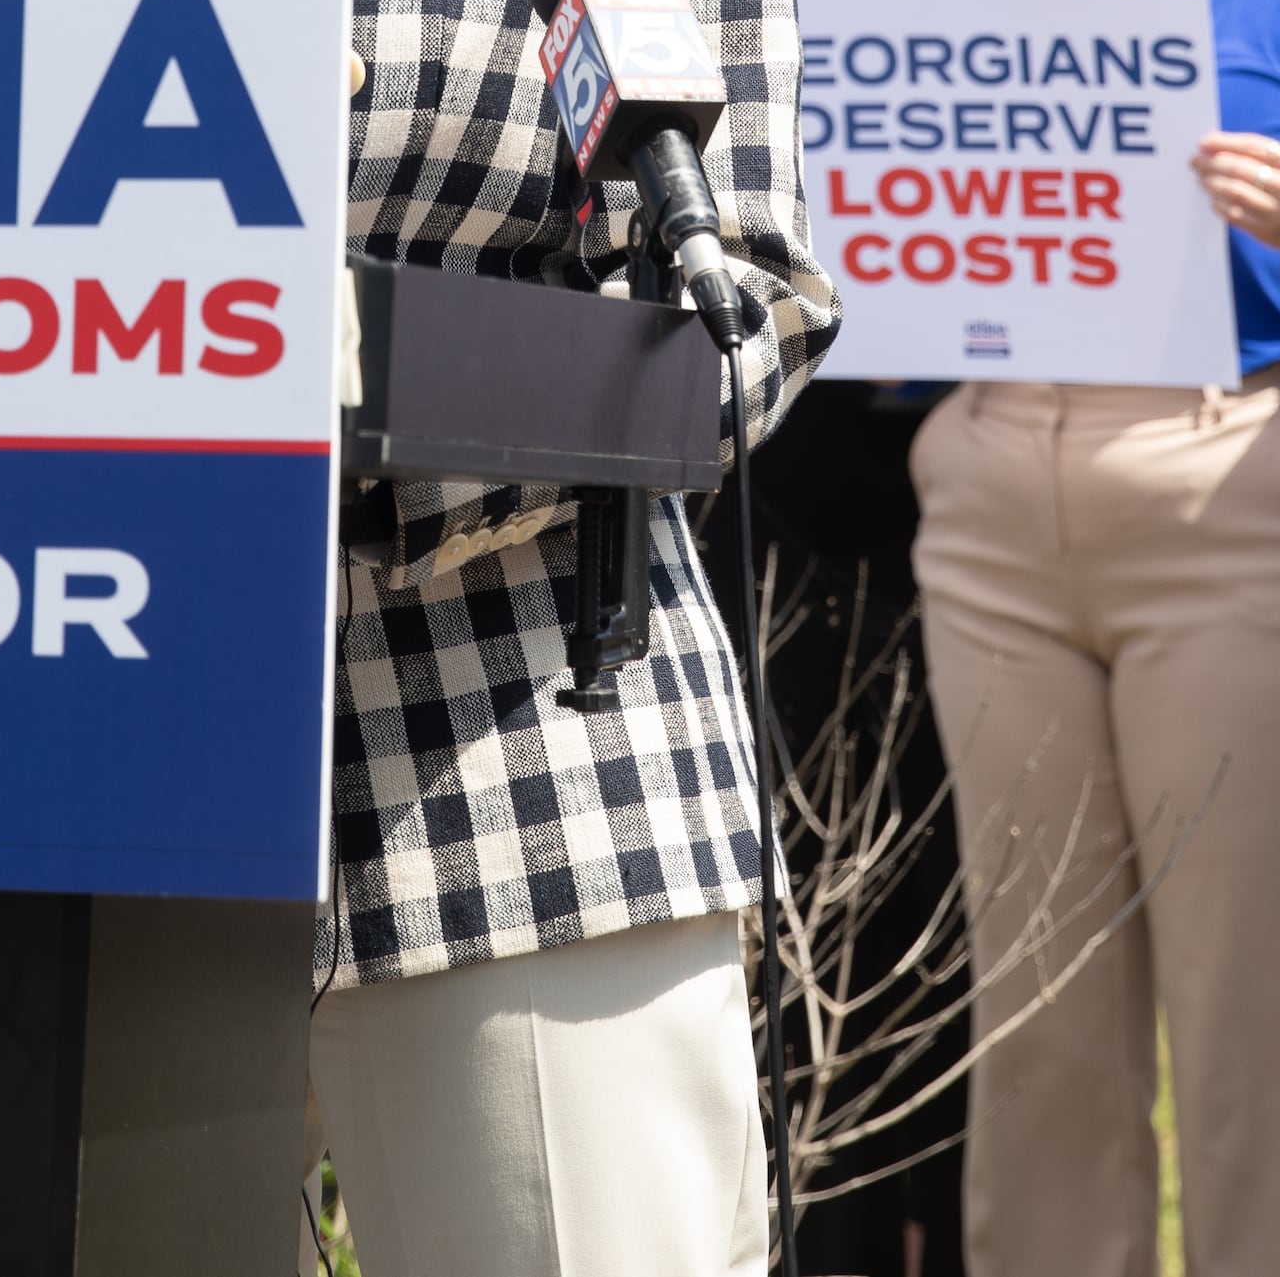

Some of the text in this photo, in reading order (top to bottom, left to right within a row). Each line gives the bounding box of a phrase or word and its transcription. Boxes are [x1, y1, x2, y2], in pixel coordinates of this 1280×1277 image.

[622, 12, 691, 74] 5
[802, 34, 1200, 90] EORGIANS
[562, 34, 598, 126] 5
[578, 92, 615, 166] NEWS
[828, 165, 1123, 222] LOWER
[842, 232, 1118, 289] COSTS
